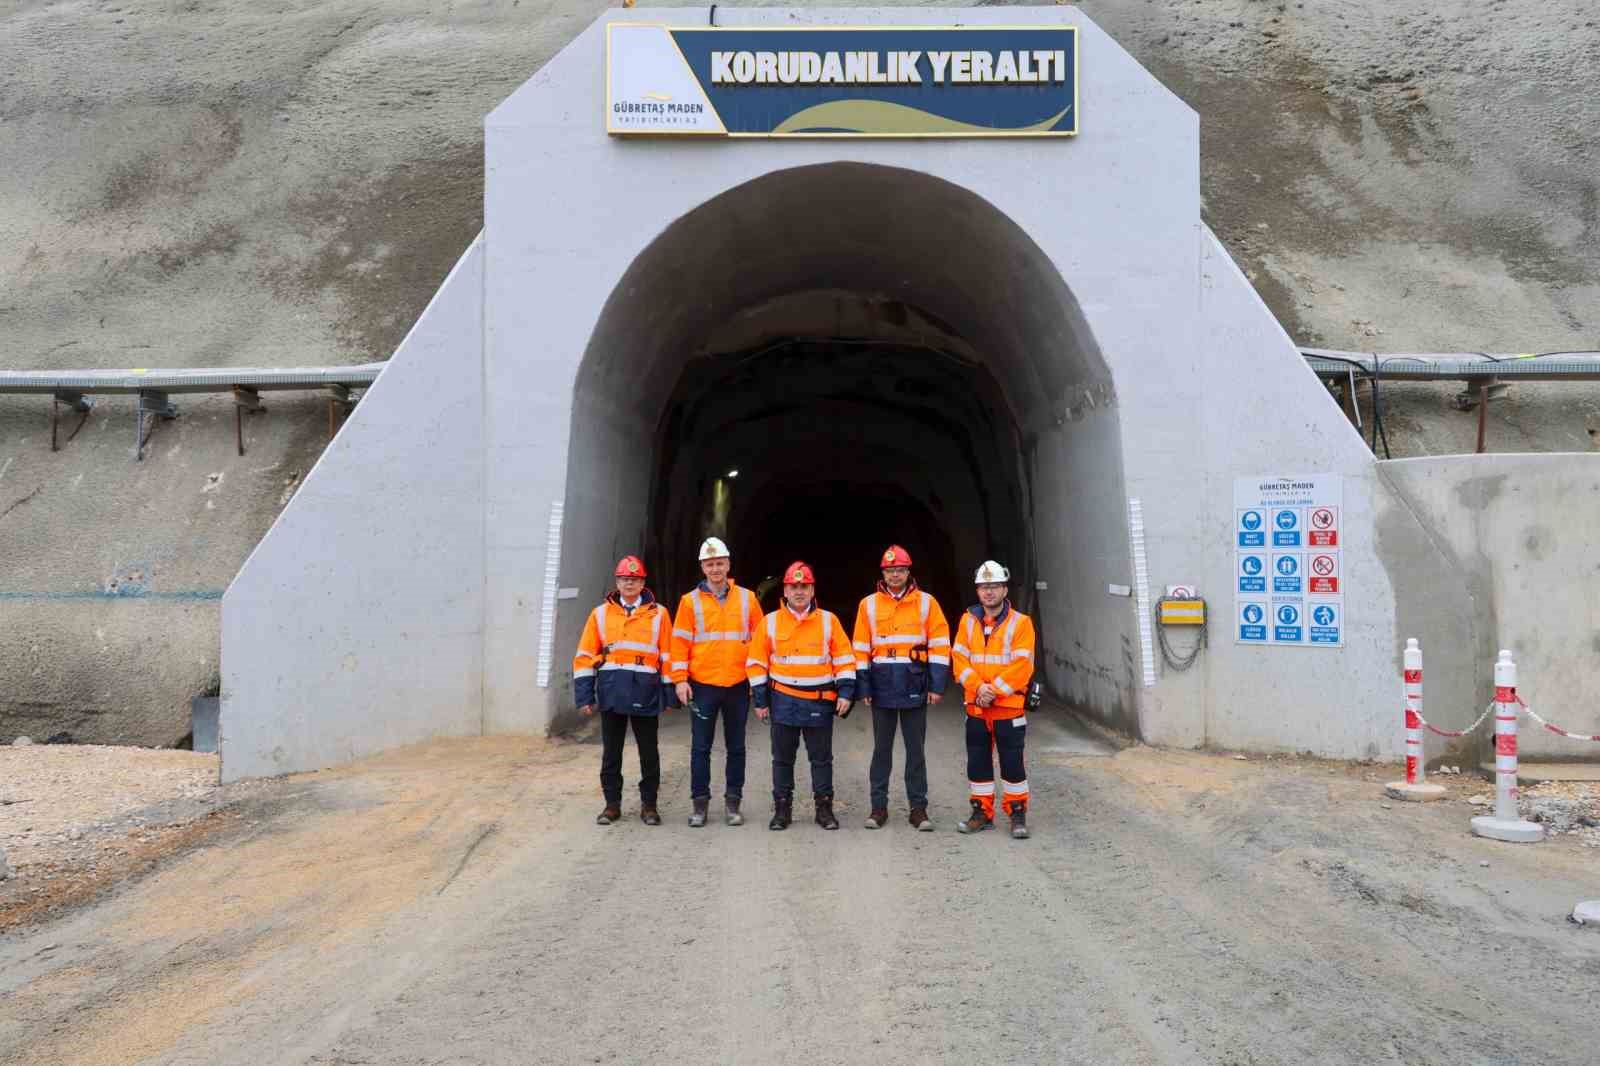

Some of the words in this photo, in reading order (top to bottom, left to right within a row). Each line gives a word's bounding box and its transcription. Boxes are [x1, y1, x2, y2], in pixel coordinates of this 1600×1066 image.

[711, 50, 921, 83] KORUDANLIK
[928, 49, 1066, 83] YERALTI
[614, 101, 665, 115] GÜBRETAŞ
[667, 103, 703, 113] MADEN
